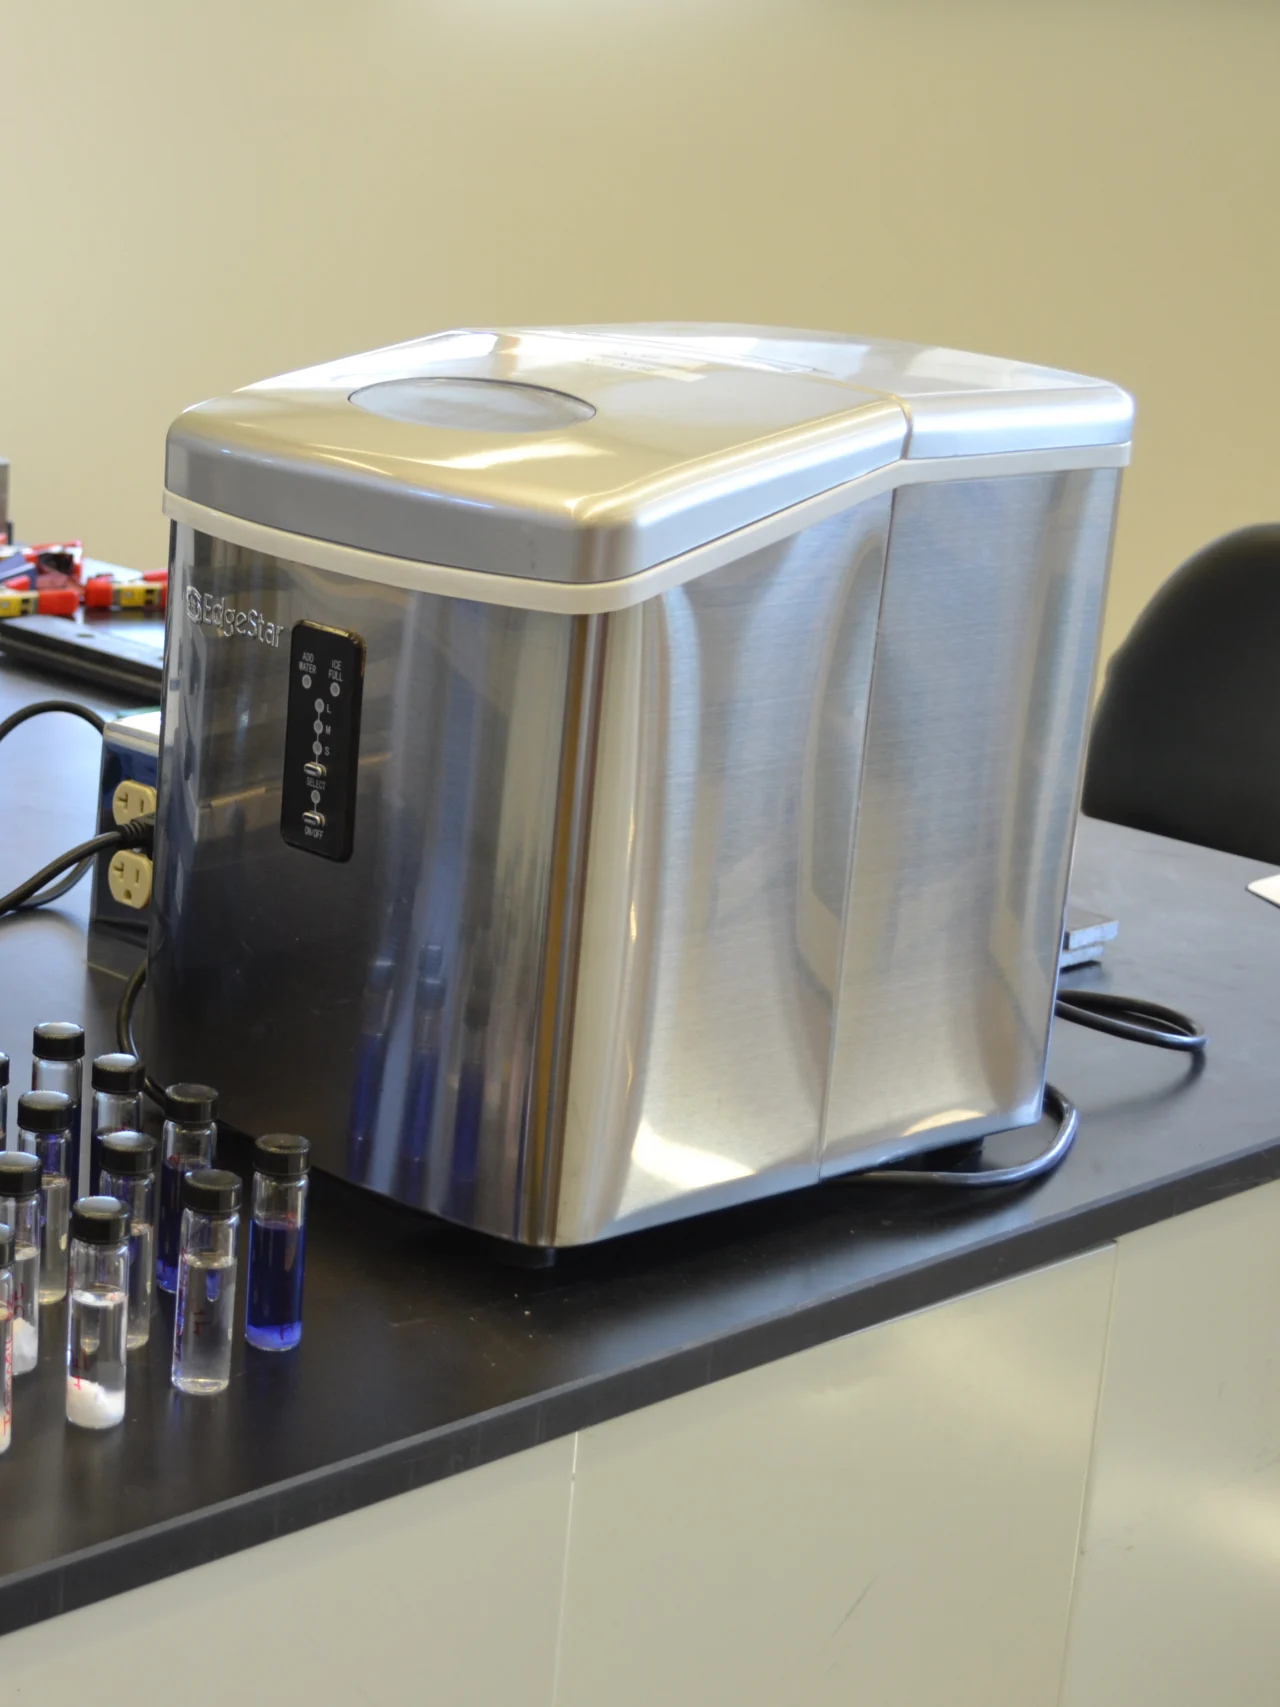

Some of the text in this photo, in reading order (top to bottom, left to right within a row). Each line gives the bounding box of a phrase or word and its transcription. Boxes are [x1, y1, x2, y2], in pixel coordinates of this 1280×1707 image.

[203, 592, 285, 649] EdgeStar
[302, 651, 315, 663] ADD
[299, 661, 317, 675] WATER
[331, 659, 342, 671] ICE
[328, 669, 344, 682] FULL
[306, 776, 326, 790] SELECT
[304, 825, 324, 839] ON/OFF
